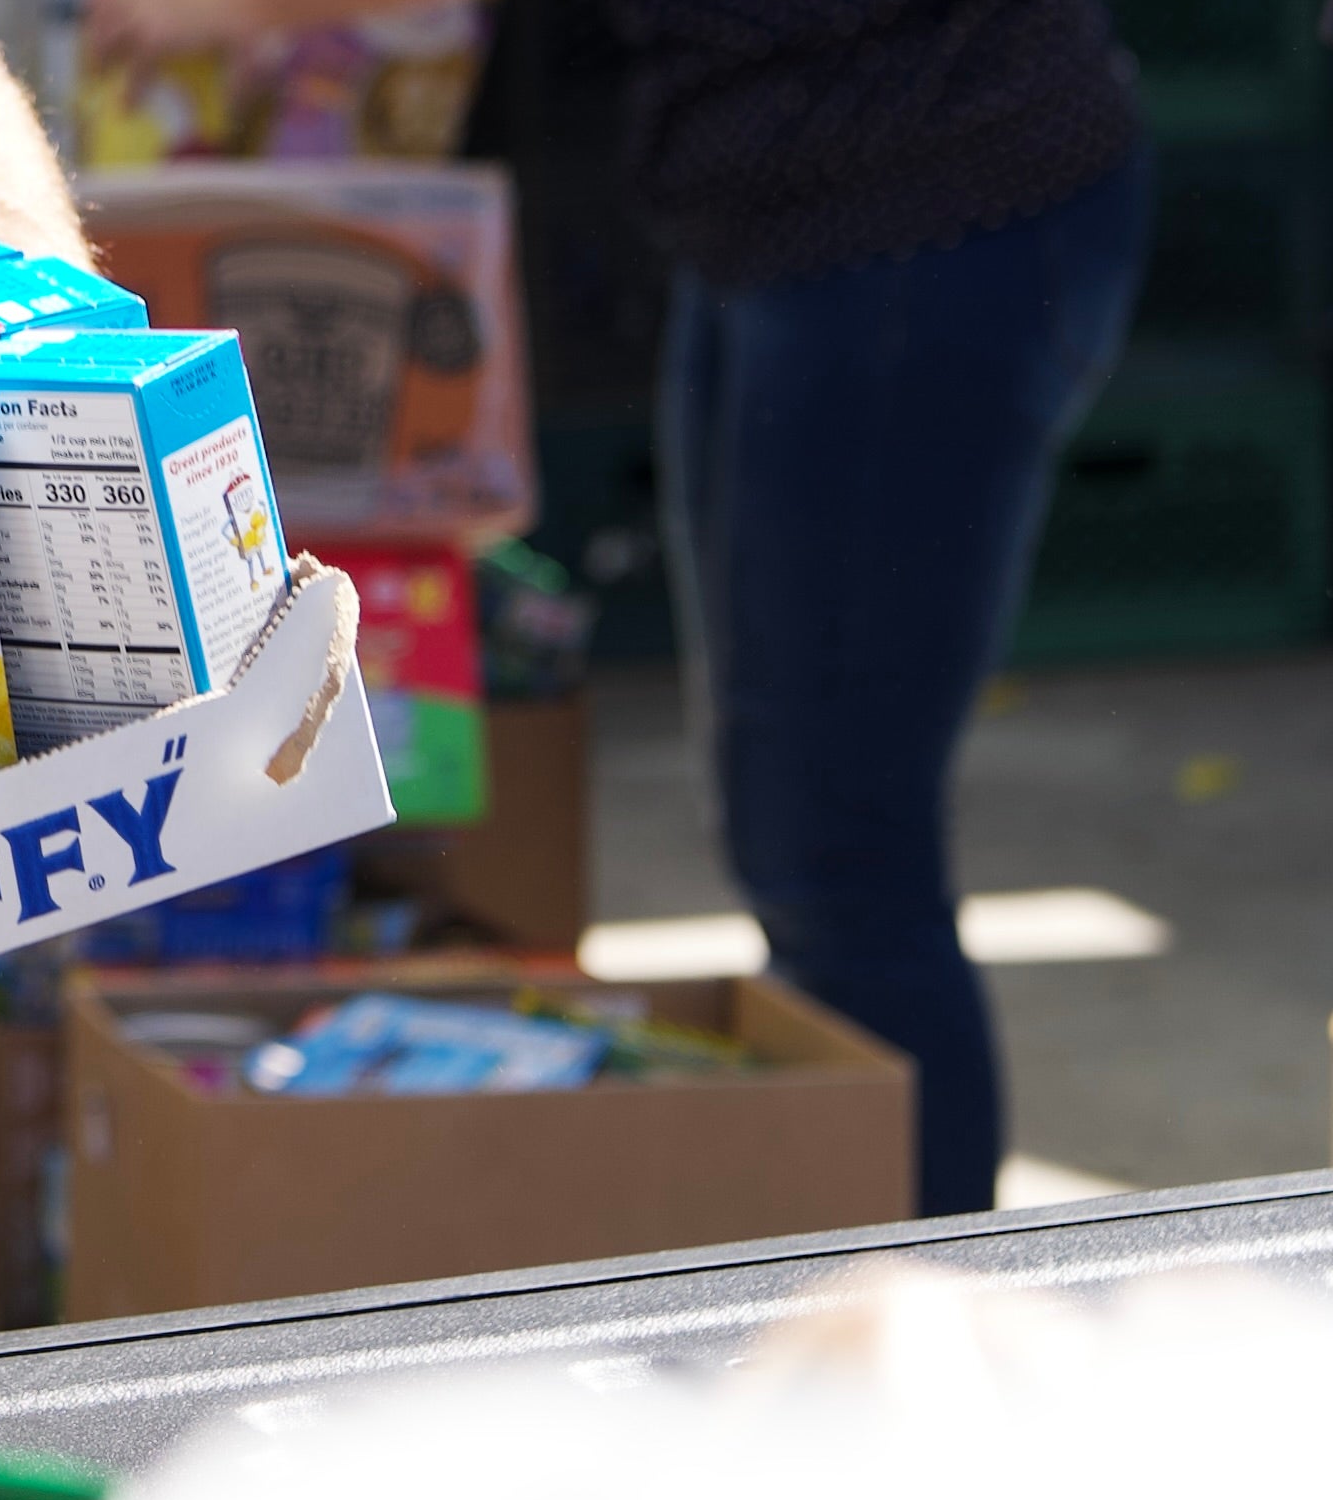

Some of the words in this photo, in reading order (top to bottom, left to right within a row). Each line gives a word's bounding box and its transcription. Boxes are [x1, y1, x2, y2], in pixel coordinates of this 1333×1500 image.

[28, 400, 77, 419] Facts
[169, 453, 200, 476] Great
[201, 427, 247, 463] products
[186, 466, 213, 487] since
[214, 450, 239, 472] 1930
[45, 483, 86, 504] 330
[103, 485, 145, 505] 360
